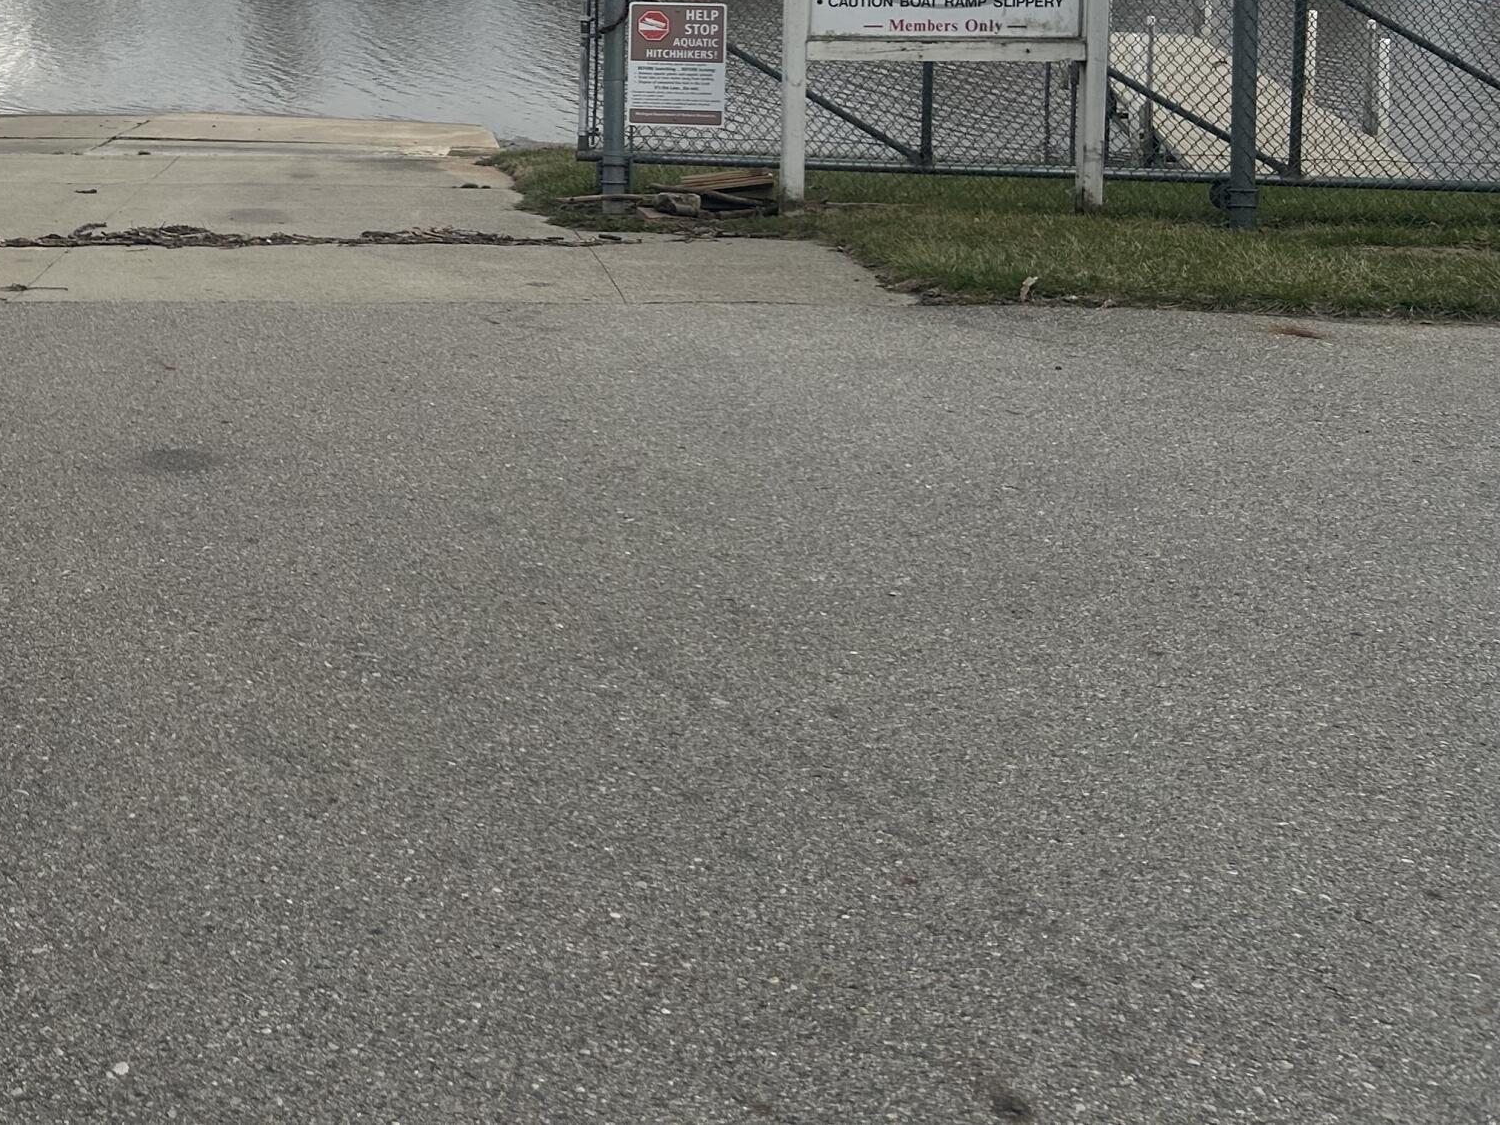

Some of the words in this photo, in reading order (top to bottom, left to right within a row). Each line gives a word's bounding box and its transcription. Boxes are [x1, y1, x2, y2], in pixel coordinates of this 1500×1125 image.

[686, 10, 719, 21] HELP
[685, 24, 719, 35] STOP
[888, 18, 958, 32] Members
[965, 18, 1003, 34] Only
[673, 38, 719, 48] AQUATIC
[646, 49, 718, 60] HITCHHIKERS!
